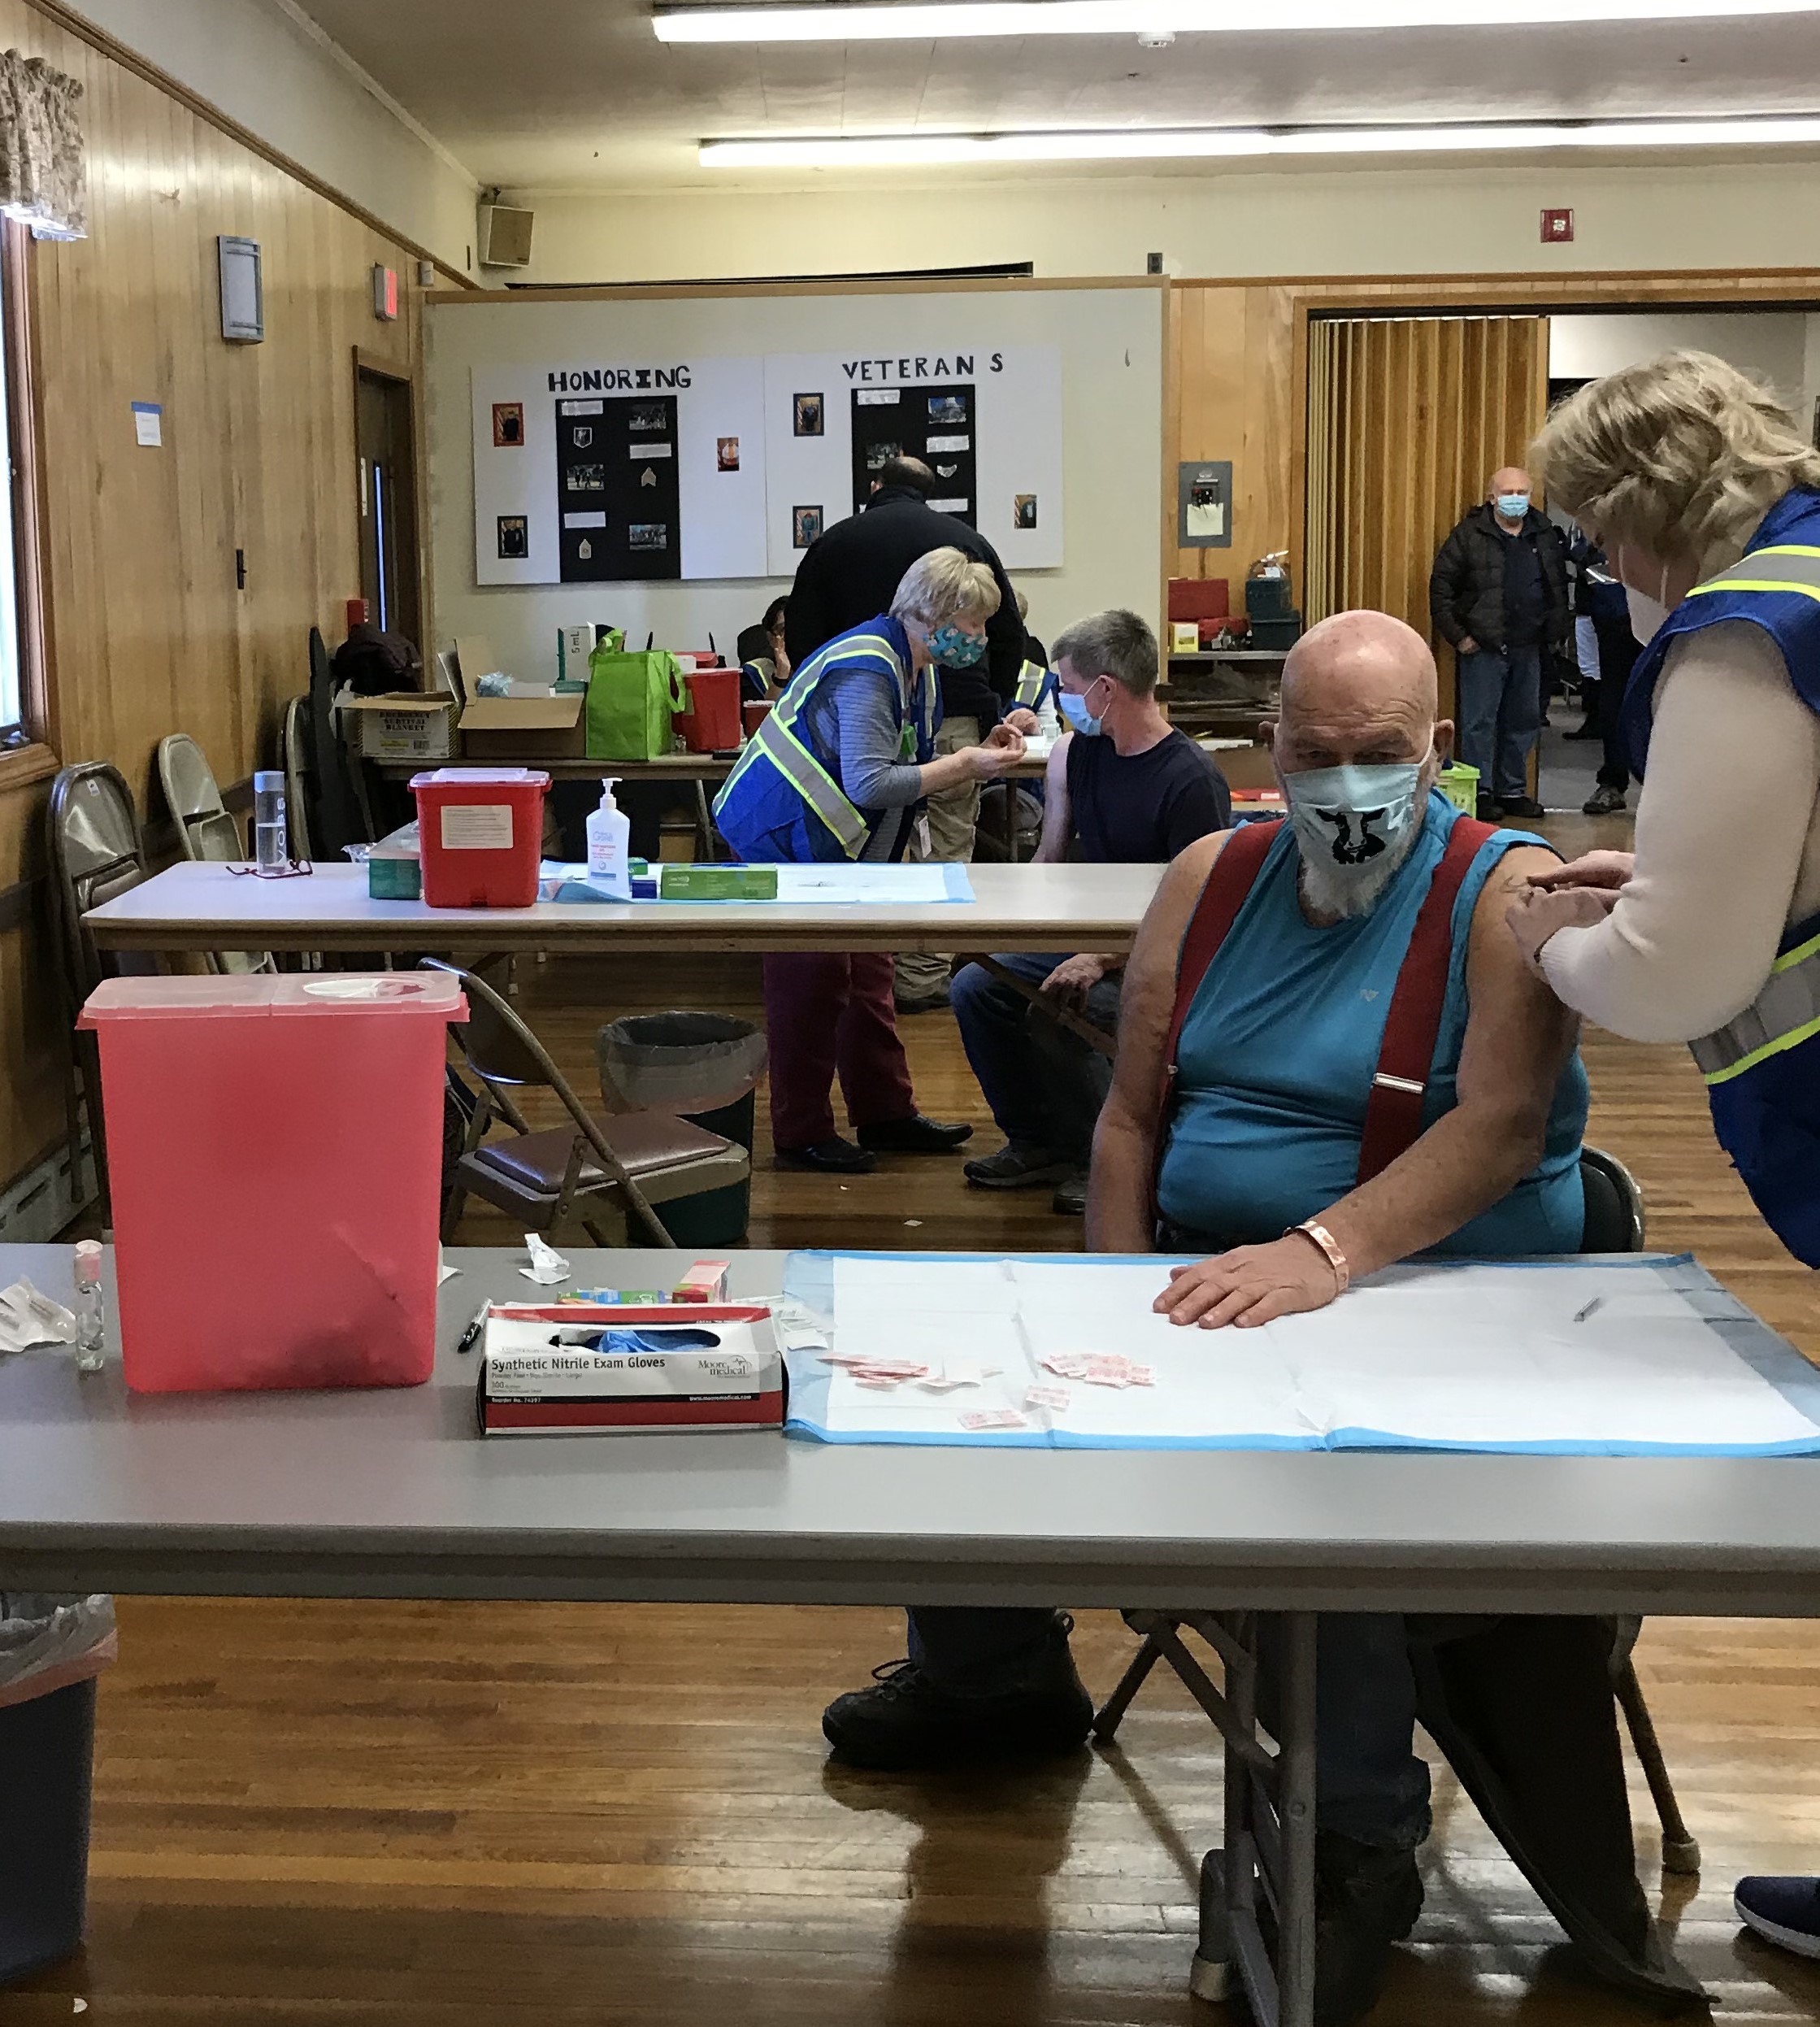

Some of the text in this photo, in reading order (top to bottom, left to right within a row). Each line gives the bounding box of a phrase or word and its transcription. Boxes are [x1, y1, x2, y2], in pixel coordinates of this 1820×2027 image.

[548, 365, 692, 392] HONORING
[276, 797, 286, 863] VOSS
[491, 1356, 666, 1372] Synthetic Nitrile Exam Gloves
[697, 1359, 746, 1375] Moore medical
